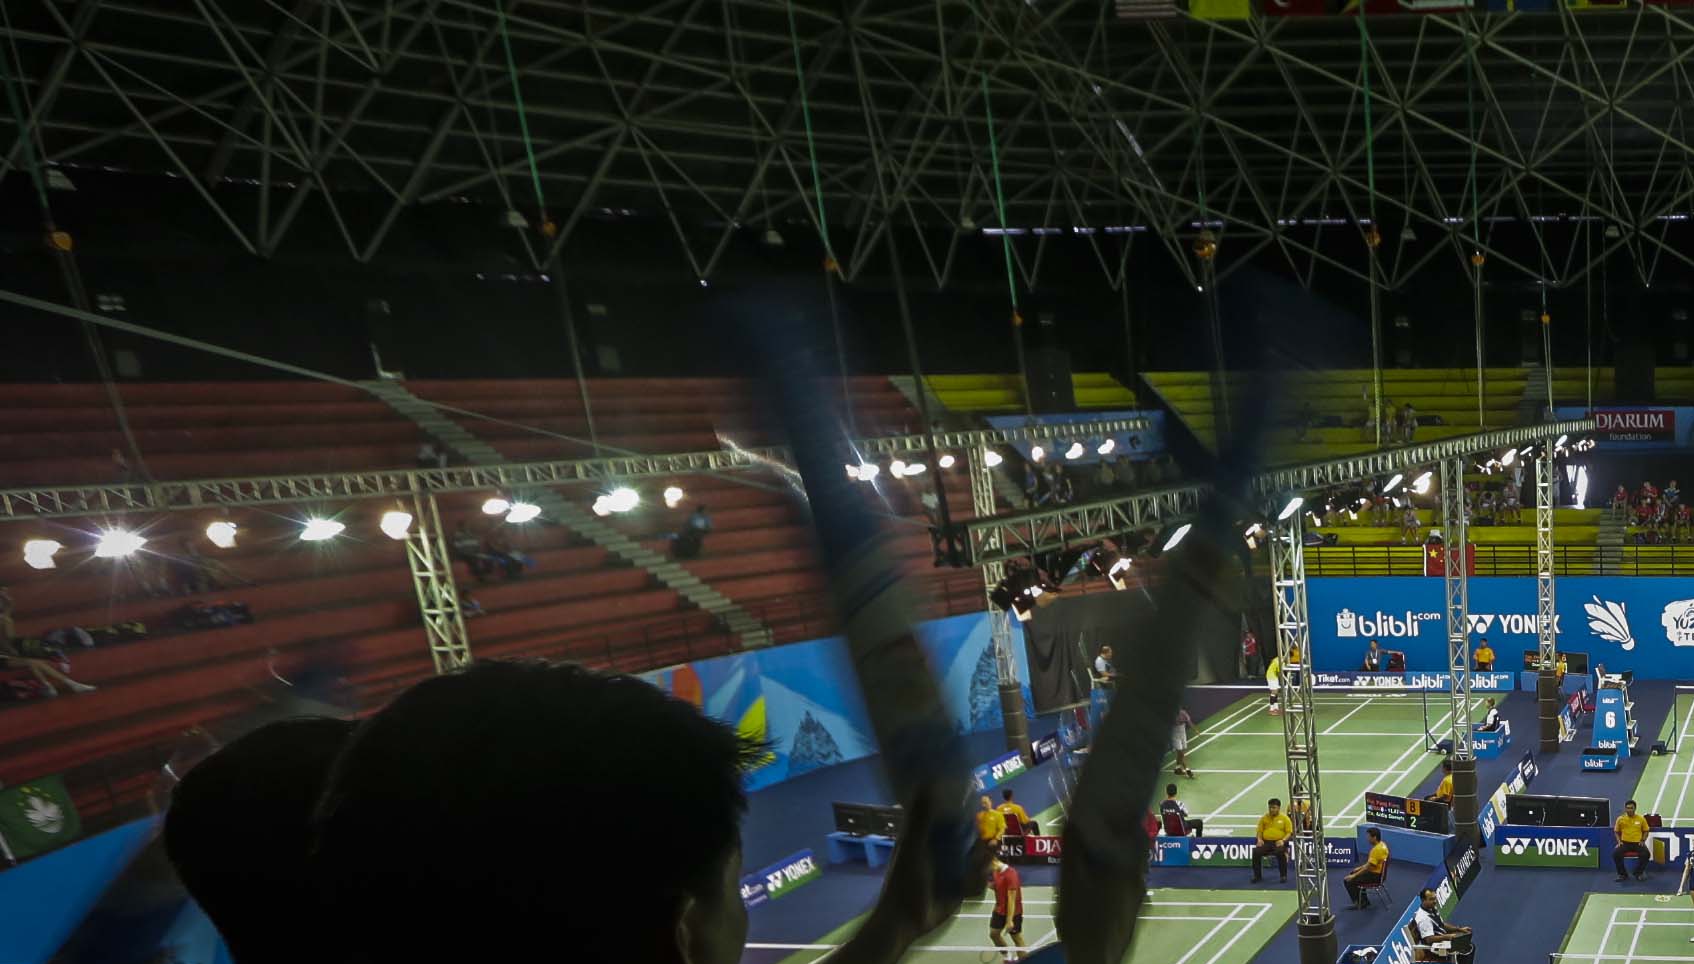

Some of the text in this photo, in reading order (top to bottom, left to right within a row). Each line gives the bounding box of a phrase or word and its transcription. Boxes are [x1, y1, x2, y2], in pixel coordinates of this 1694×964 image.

[1595, 412, 1664, 430] DJARUM
[1609, 433, 1651, 441] foundation
[1372, 676, 1404, 687] YONEX
[1605, 711, 1616, 728] 6
[1409, 816, 1417, 828] 2
[1534, 838, 1589, 857] YONEX
[783, 855, 817, 883] YONEX
